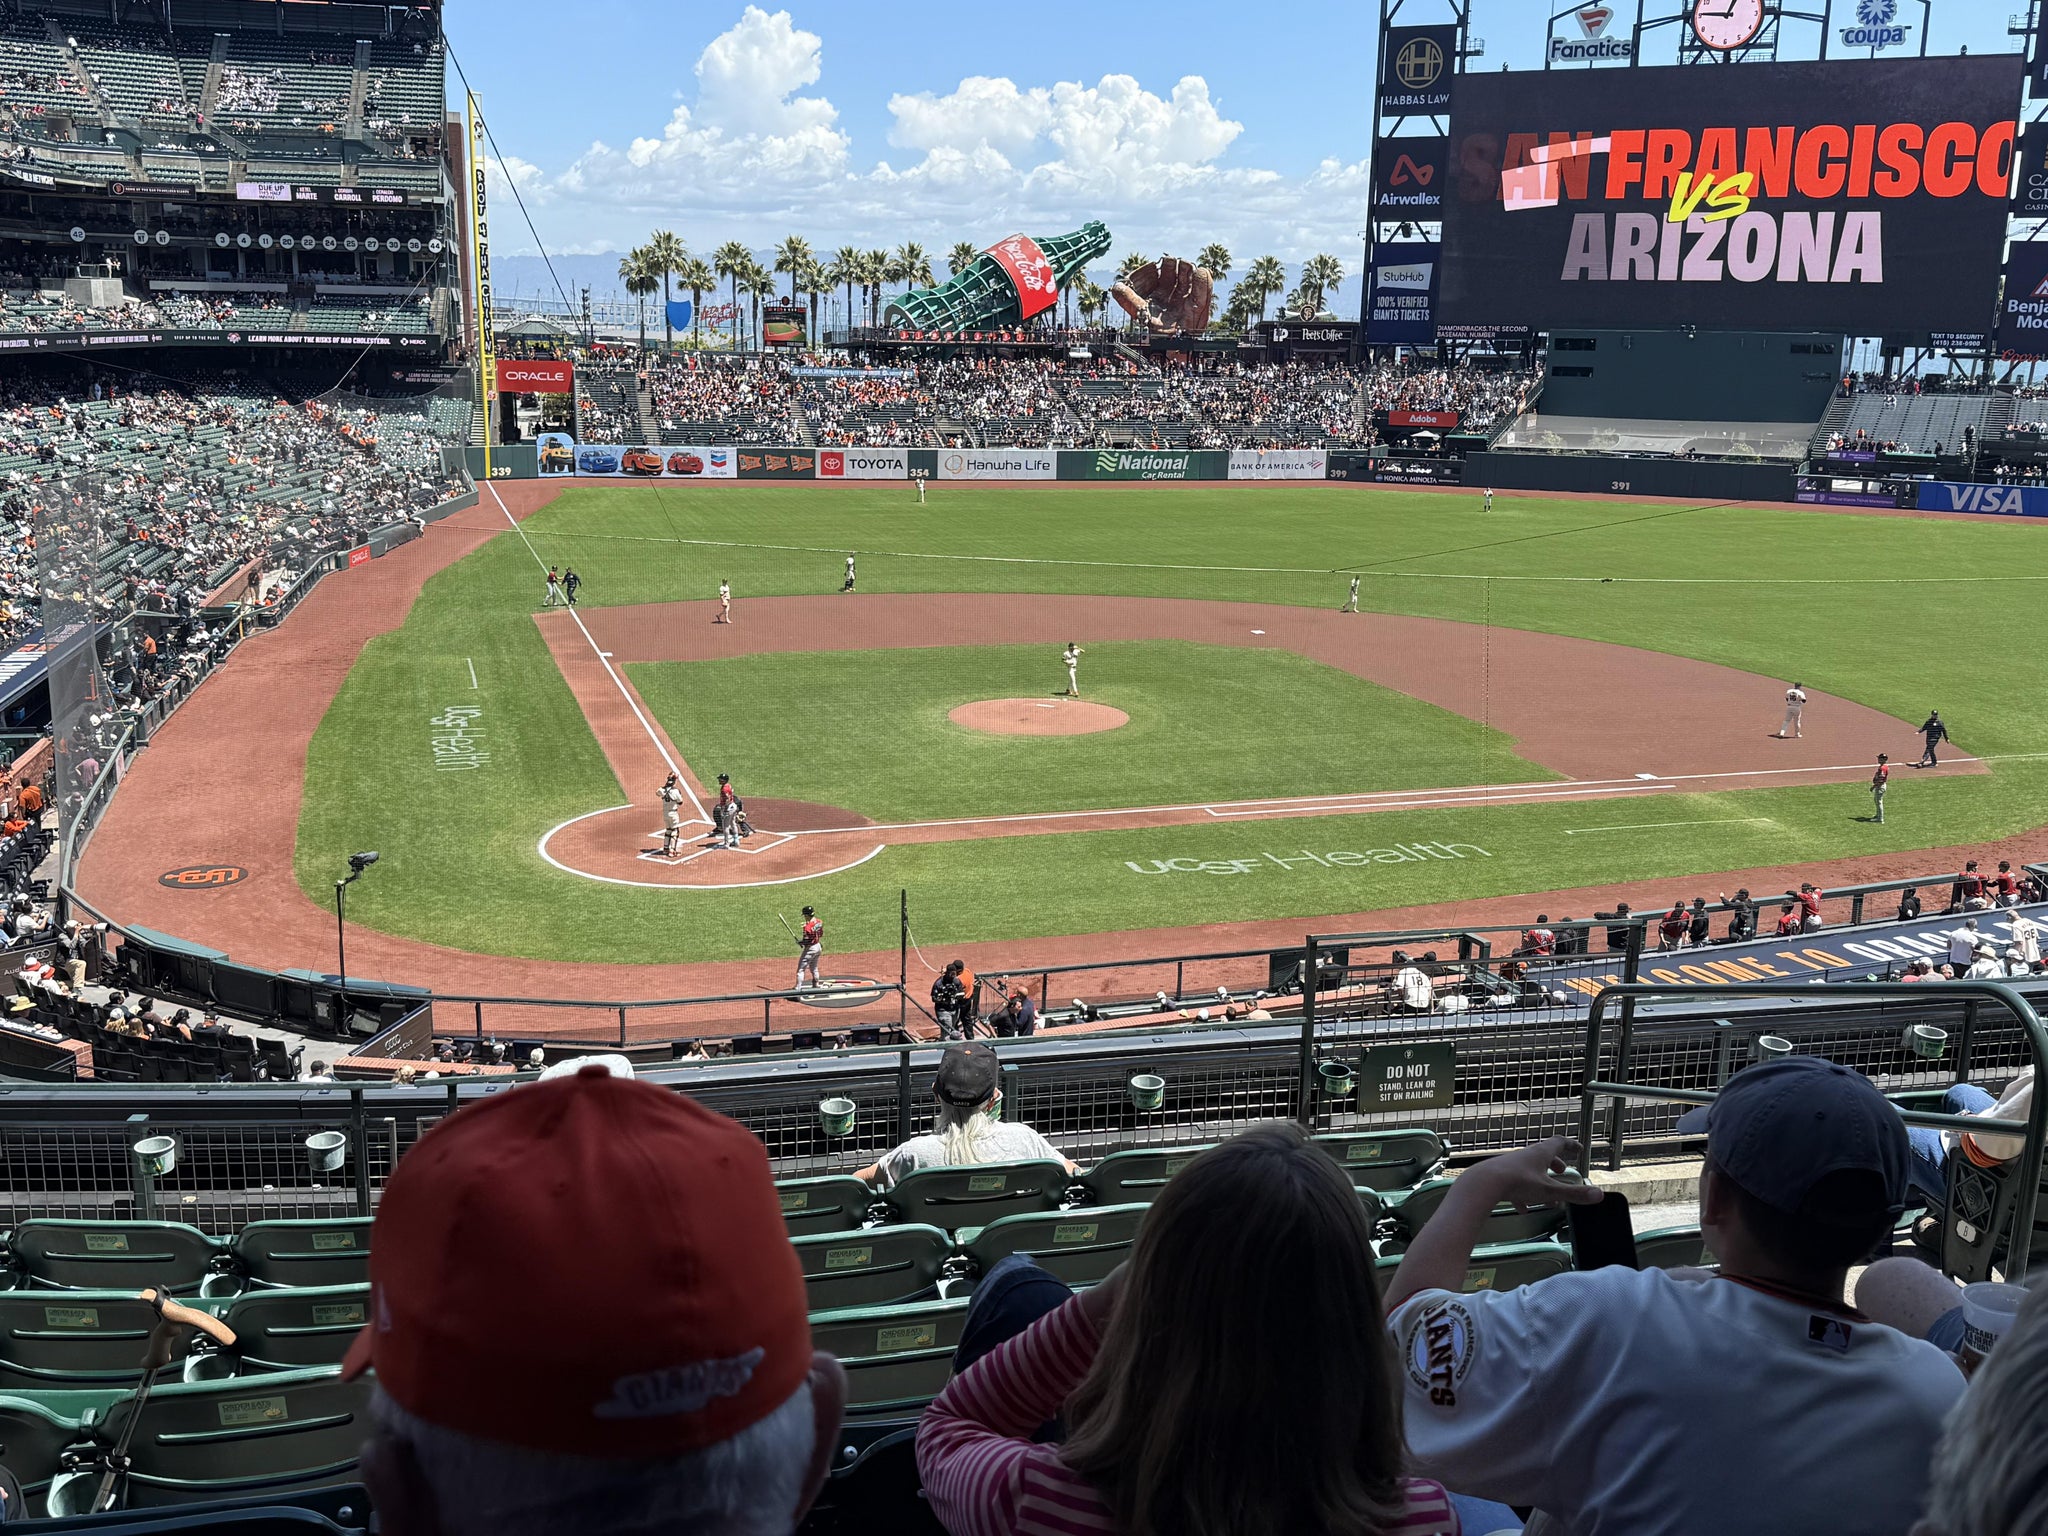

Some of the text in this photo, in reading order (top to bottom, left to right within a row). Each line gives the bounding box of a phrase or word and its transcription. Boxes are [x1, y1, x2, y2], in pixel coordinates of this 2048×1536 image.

[1844, 26, 1903, 47] coupa
[1551, 39, 1631, 58] Fanatics
[1385, 93, 1450, 105] HABBAS LAW
[1605, 121, 2015, 199] FRANCISCO
[334, 194, 362, 202] CARROLL
[372, 195, 403, 203] PERDOMO
[1380, 193, 1440, 205] Airwallex
[1668, 172, 1755, 223] VS
[220, 236, 225, 244] 3
[304, 238, 313, 246] 22
[367, 240, 377, 248] 27
[1561, 212, 1883, 283] ARIZONA
[1384, 272, 1424, 282] StubHub
[1377, 296, 1429, 308] 100% VERIFIED
[1373, 309, 1430, 321] GIANTS TICKETS
[1302, 328, 1343, 341] Peet's Coffee
[1956, 333, 1984, 341] SECURITY
[2002, 348, 2039, 362] Coors
[506, 371, 565, 381] ORACLE
[1409, 414, 1437, 424] Adobe
[849, 458, 903, 469] TOYOTA
[967, 460, 1050, 471] Hanwha Life
[1118, 455, 1188, 470] National
[491, 467, 511, 476] 339
[910, 468, 929, 477] 354
[1142, 471, 1185, 479] Car Rental
[1330, 469, 1347, 478] 399
[1409, 476, 1437, 484] MINOLTA
[1611, 481, 1630, 491] 391
[1944, 485, 2024, 514] VISA
[1124, 841, 1492, 875] UCSF Health
[1776, 948, 1852, 970] TO
[4, 966, 22, 976] Audi
[1411, 975, 1423, 986] 18
[1387, 1064, 1430, 1079] DO NOT
[1379, 1080, 1436, 1092] STAND, LEAN OR
[1380, 1090, 1434, 1102] SIT ON RAILING
[1423, 1300, 1456, 1406] GIANTS
